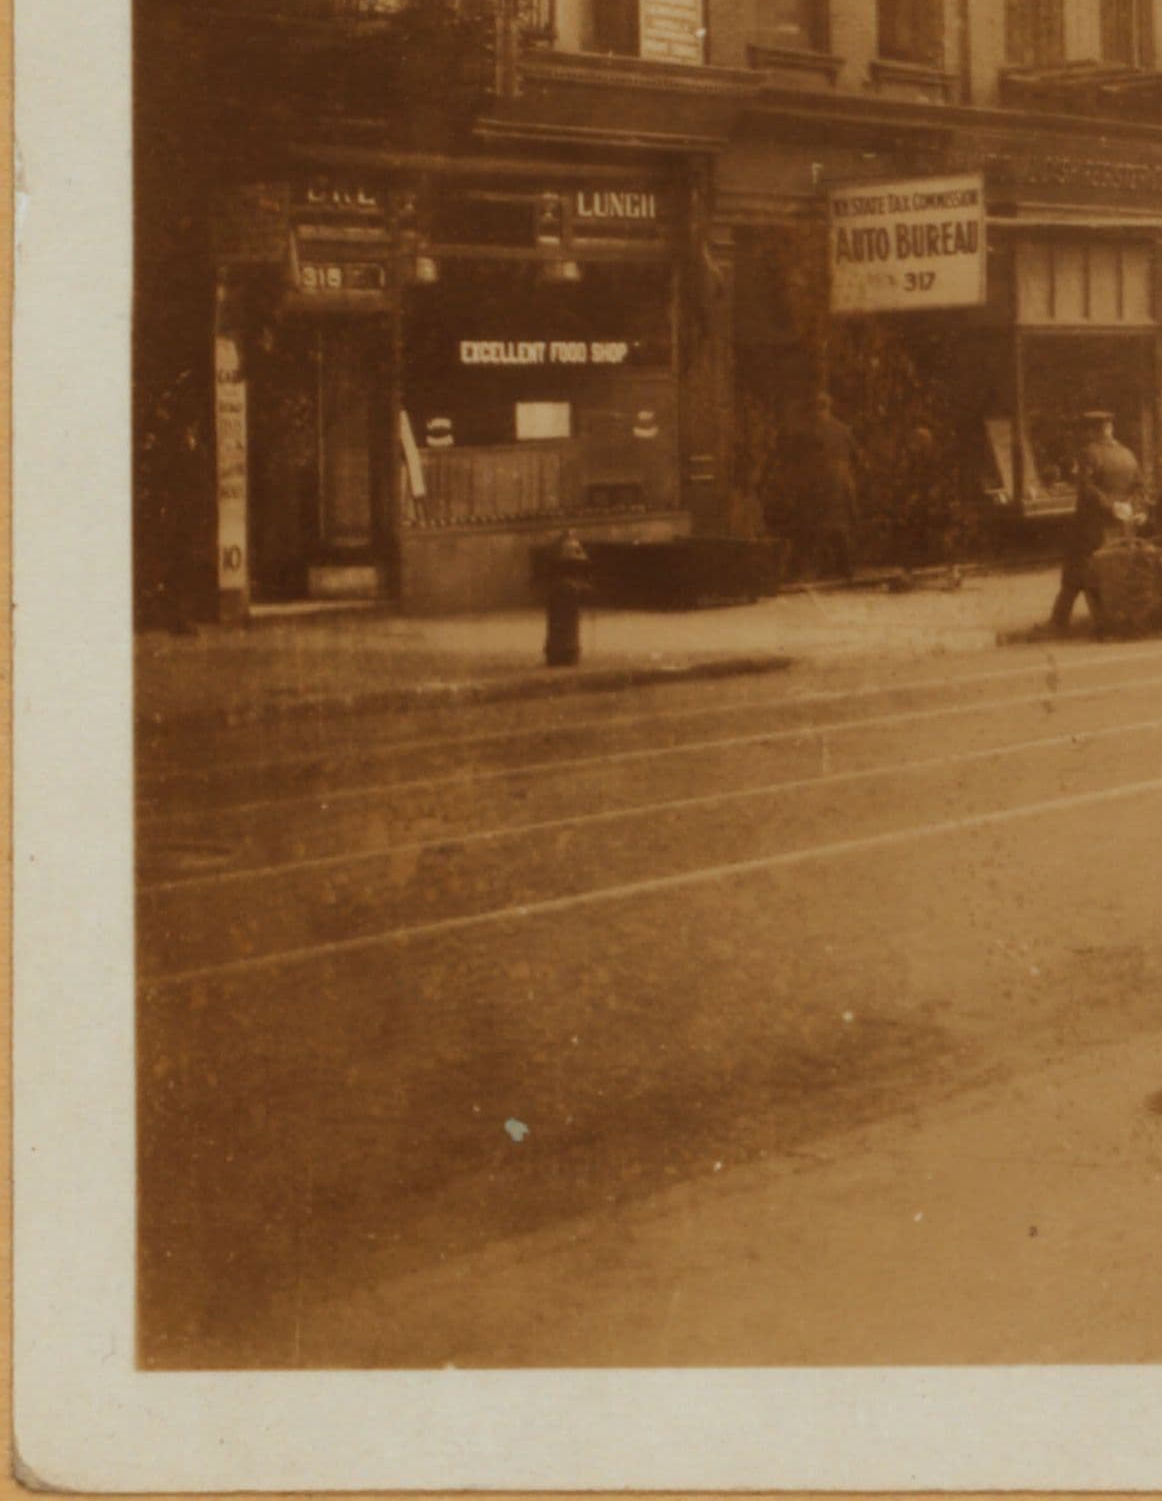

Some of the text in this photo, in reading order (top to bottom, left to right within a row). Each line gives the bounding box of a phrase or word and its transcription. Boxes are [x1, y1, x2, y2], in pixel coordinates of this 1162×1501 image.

[577, 191, 655, 218] LUNCH
[852, 196, 885, 216] STATE
[888, 193, 911, 213] TAX
[912, 189, 978, 211] COMMISSION
[836, 220, 979, 265] AUTO BUREAU
[904, 271, 936, 292] 317
[460, 340, 628, 364] EXCELLENT FOOD SHOP
